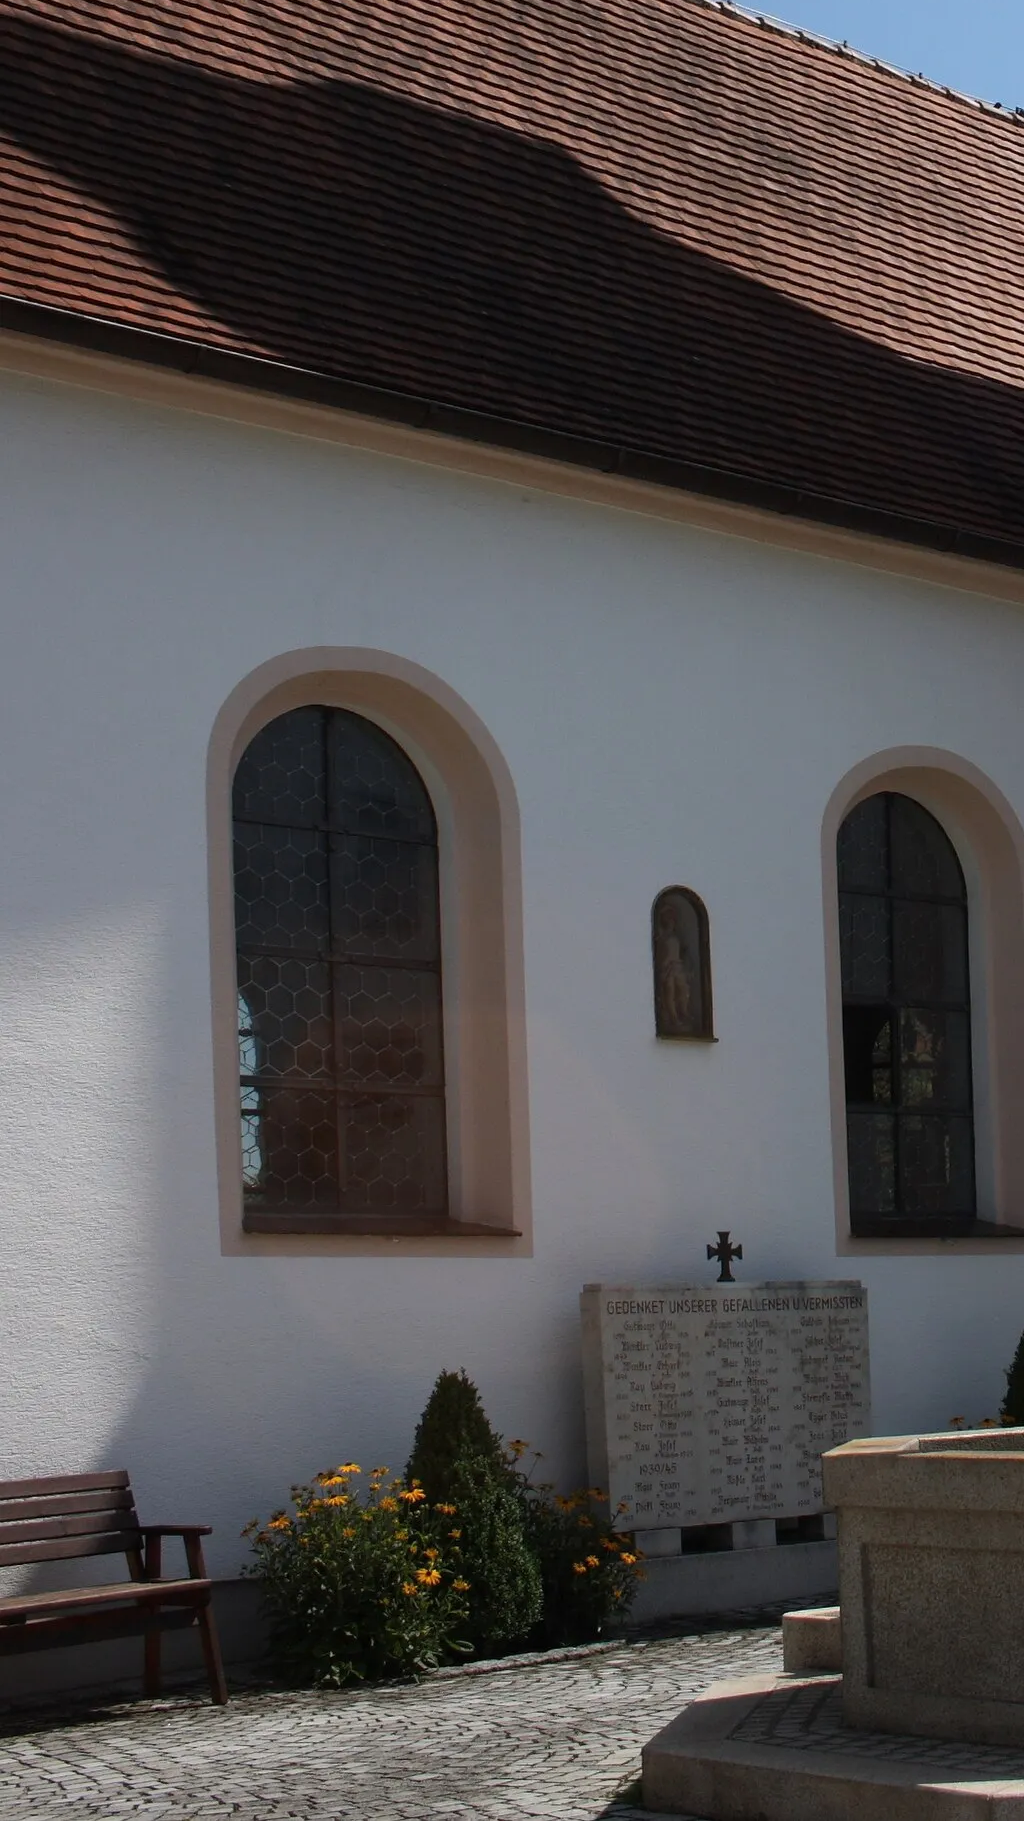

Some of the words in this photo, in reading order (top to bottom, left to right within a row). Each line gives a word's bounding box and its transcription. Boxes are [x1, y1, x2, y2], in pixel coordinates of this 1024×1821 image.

[607, 1300, 664, 1315] GEDENKET
[669, 1299, 718, 1313] UNSERER
[723, 1297, 790, 1312] GEFALLENEN
[805, 1296, 863, 1310] VERMISSTEN
